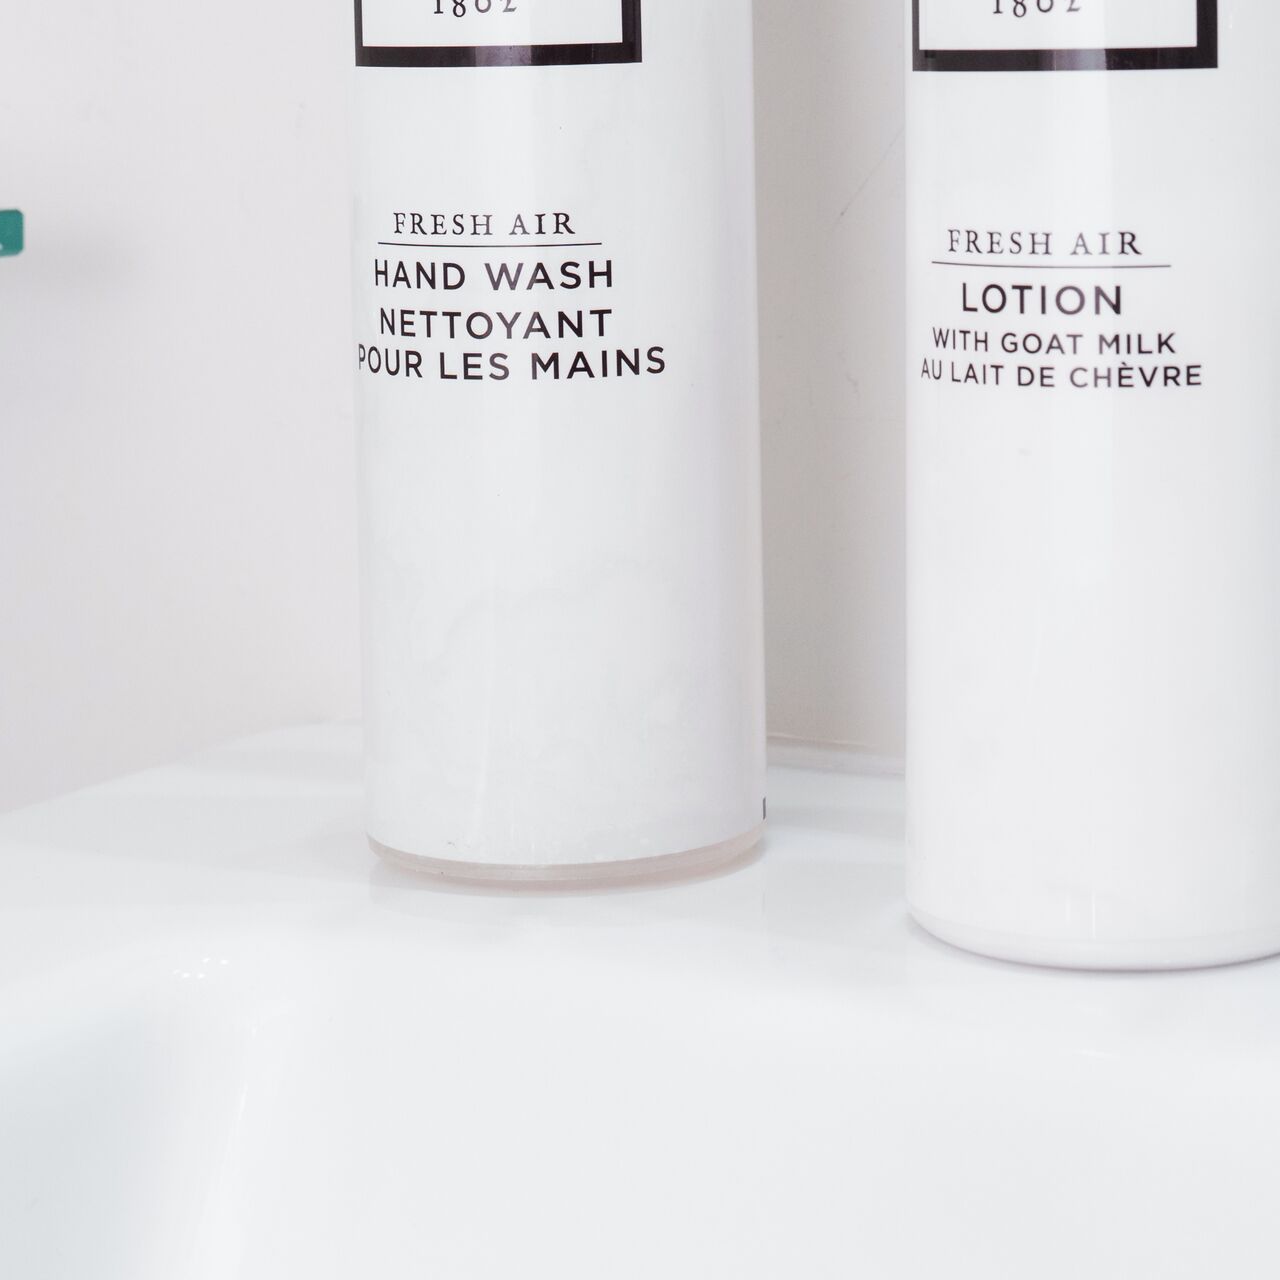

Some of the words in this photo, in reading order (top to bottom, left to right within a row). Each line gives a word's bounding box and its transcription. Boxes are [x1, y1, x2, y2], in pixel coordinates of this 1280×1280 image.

[392, 212, 493, 235] FRESH
[508, 211, 577, 234] AIR
[947, 228, 1053, 255] FRESH
[1070, 230, 1144, 255] AIR
[373, 258, 467, 290] HAND
[483, 258, 614, 289] WASH
[961, 282, 1123, 315] LOTION
[378, 307, 614, 339] NETTOYANT
[931, 326, 990, 352] WITH
[1000, 331, 1085, 354] GOAT
[1098, 332, 1177, 355] MILK
[357, 343, 424, 378] POUR
[439, 351, 510, 380] LES
[530, 345, 667, 380] MAINS
[920, 356, 943, 379] AU
[951, 360, 1006, 385] LAIT
[1016, 365, 1056, 387] DE
[1069, 360, 1204, 388] CHÈVRE
